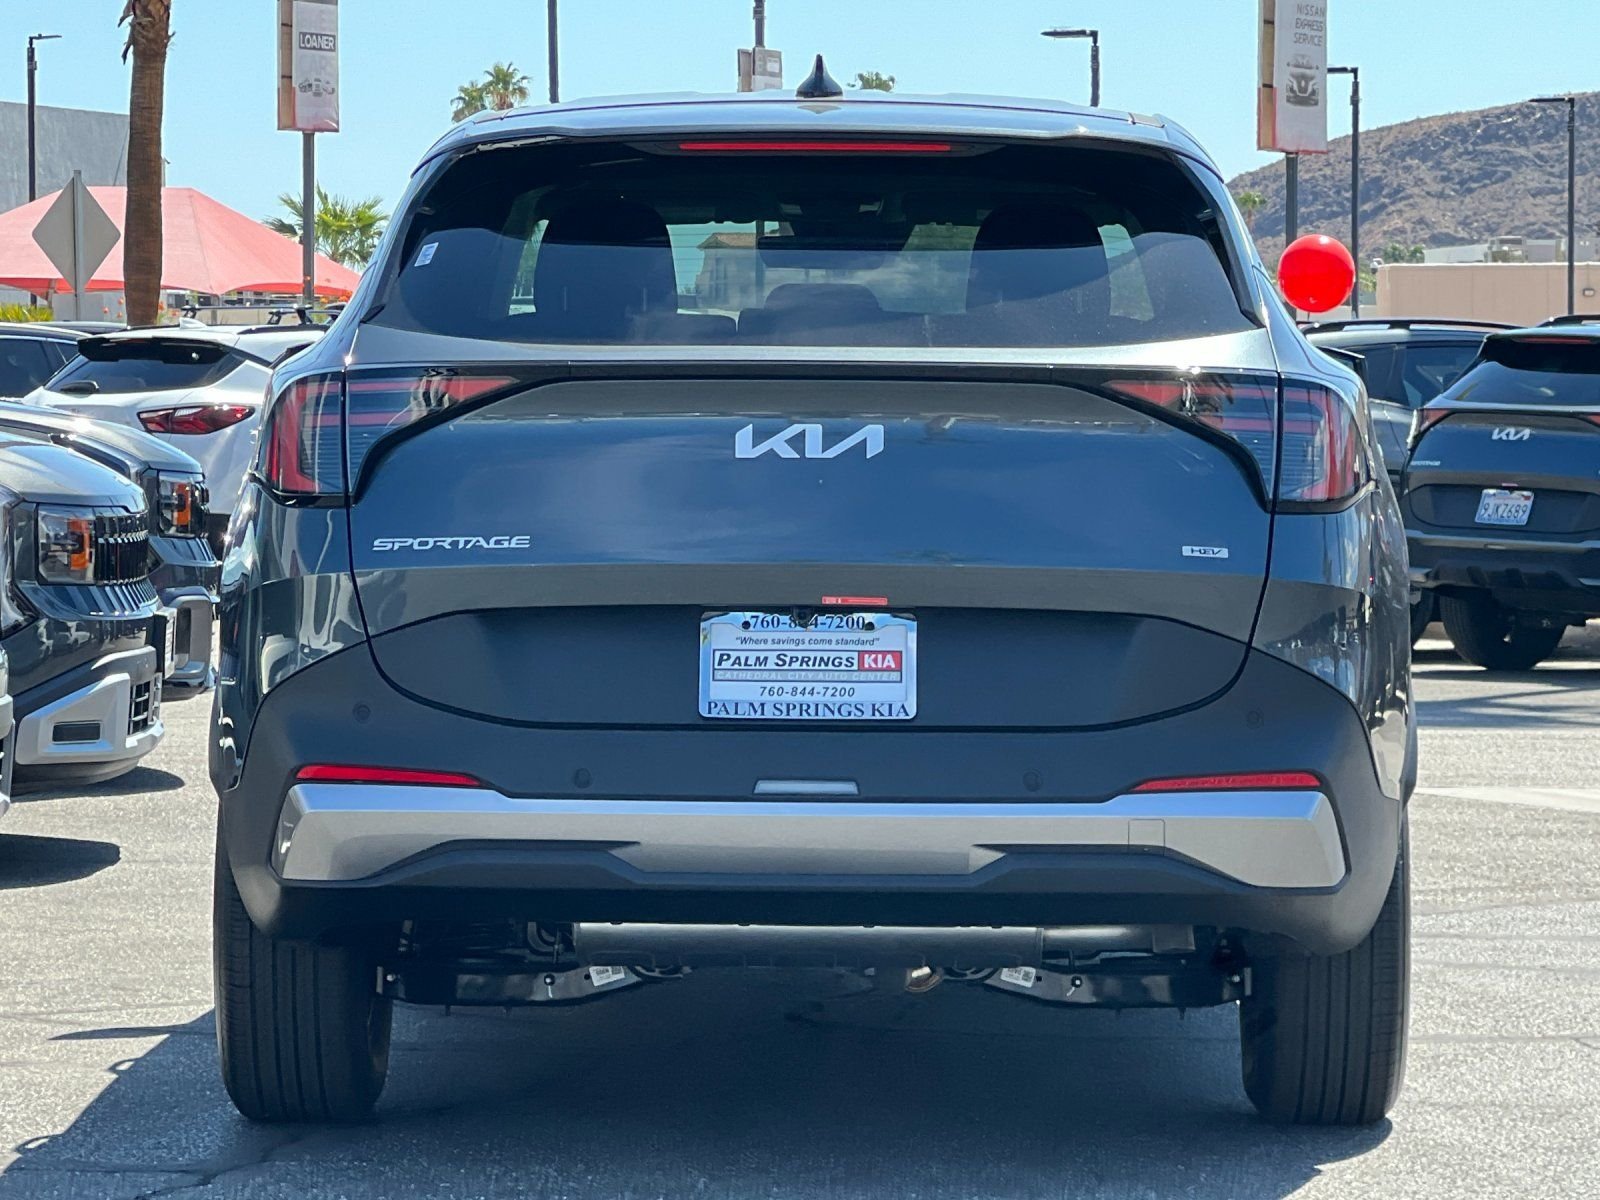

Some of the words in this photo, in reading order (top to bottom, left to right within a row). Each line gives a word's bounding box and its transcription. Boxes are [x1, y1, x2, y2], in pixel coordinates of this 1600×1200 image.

[1297, 4, 1325, 17] NISSAN
[1295, 18, 1323, 31] EXPRESS
[300, 34, 335, 50] LOANER
[1294, 33, 1322, 46] SERVICE
[735, 423, 884, 459] KIA
[1480, 503, 1528, 518] 9JKZ689
[372, 535, 531, 551] SPORTAGE
[750, 614, 866, 631] 760-84-7200
[770, 637, 806, 647] savings
[807, 638, 833, 646] come
[717, 652, 769, 668] PALM
[773, 653, 855, 669] SPRINGS
[864, 653, 896, 669] KIA
[716, 671, 782, 680] CATHEDRAL
[787, 671, 814, 681] CITY
[817, 672, 849, 681] AUTO
[852, 672, 898, 682] CENTER
[759, 686, 855, 698] 760-844-7200
[706, 700, 767, 717] PALM
[772, 702, 865, 718] SPRINGS
[870, 702, 910, 718] KIA
